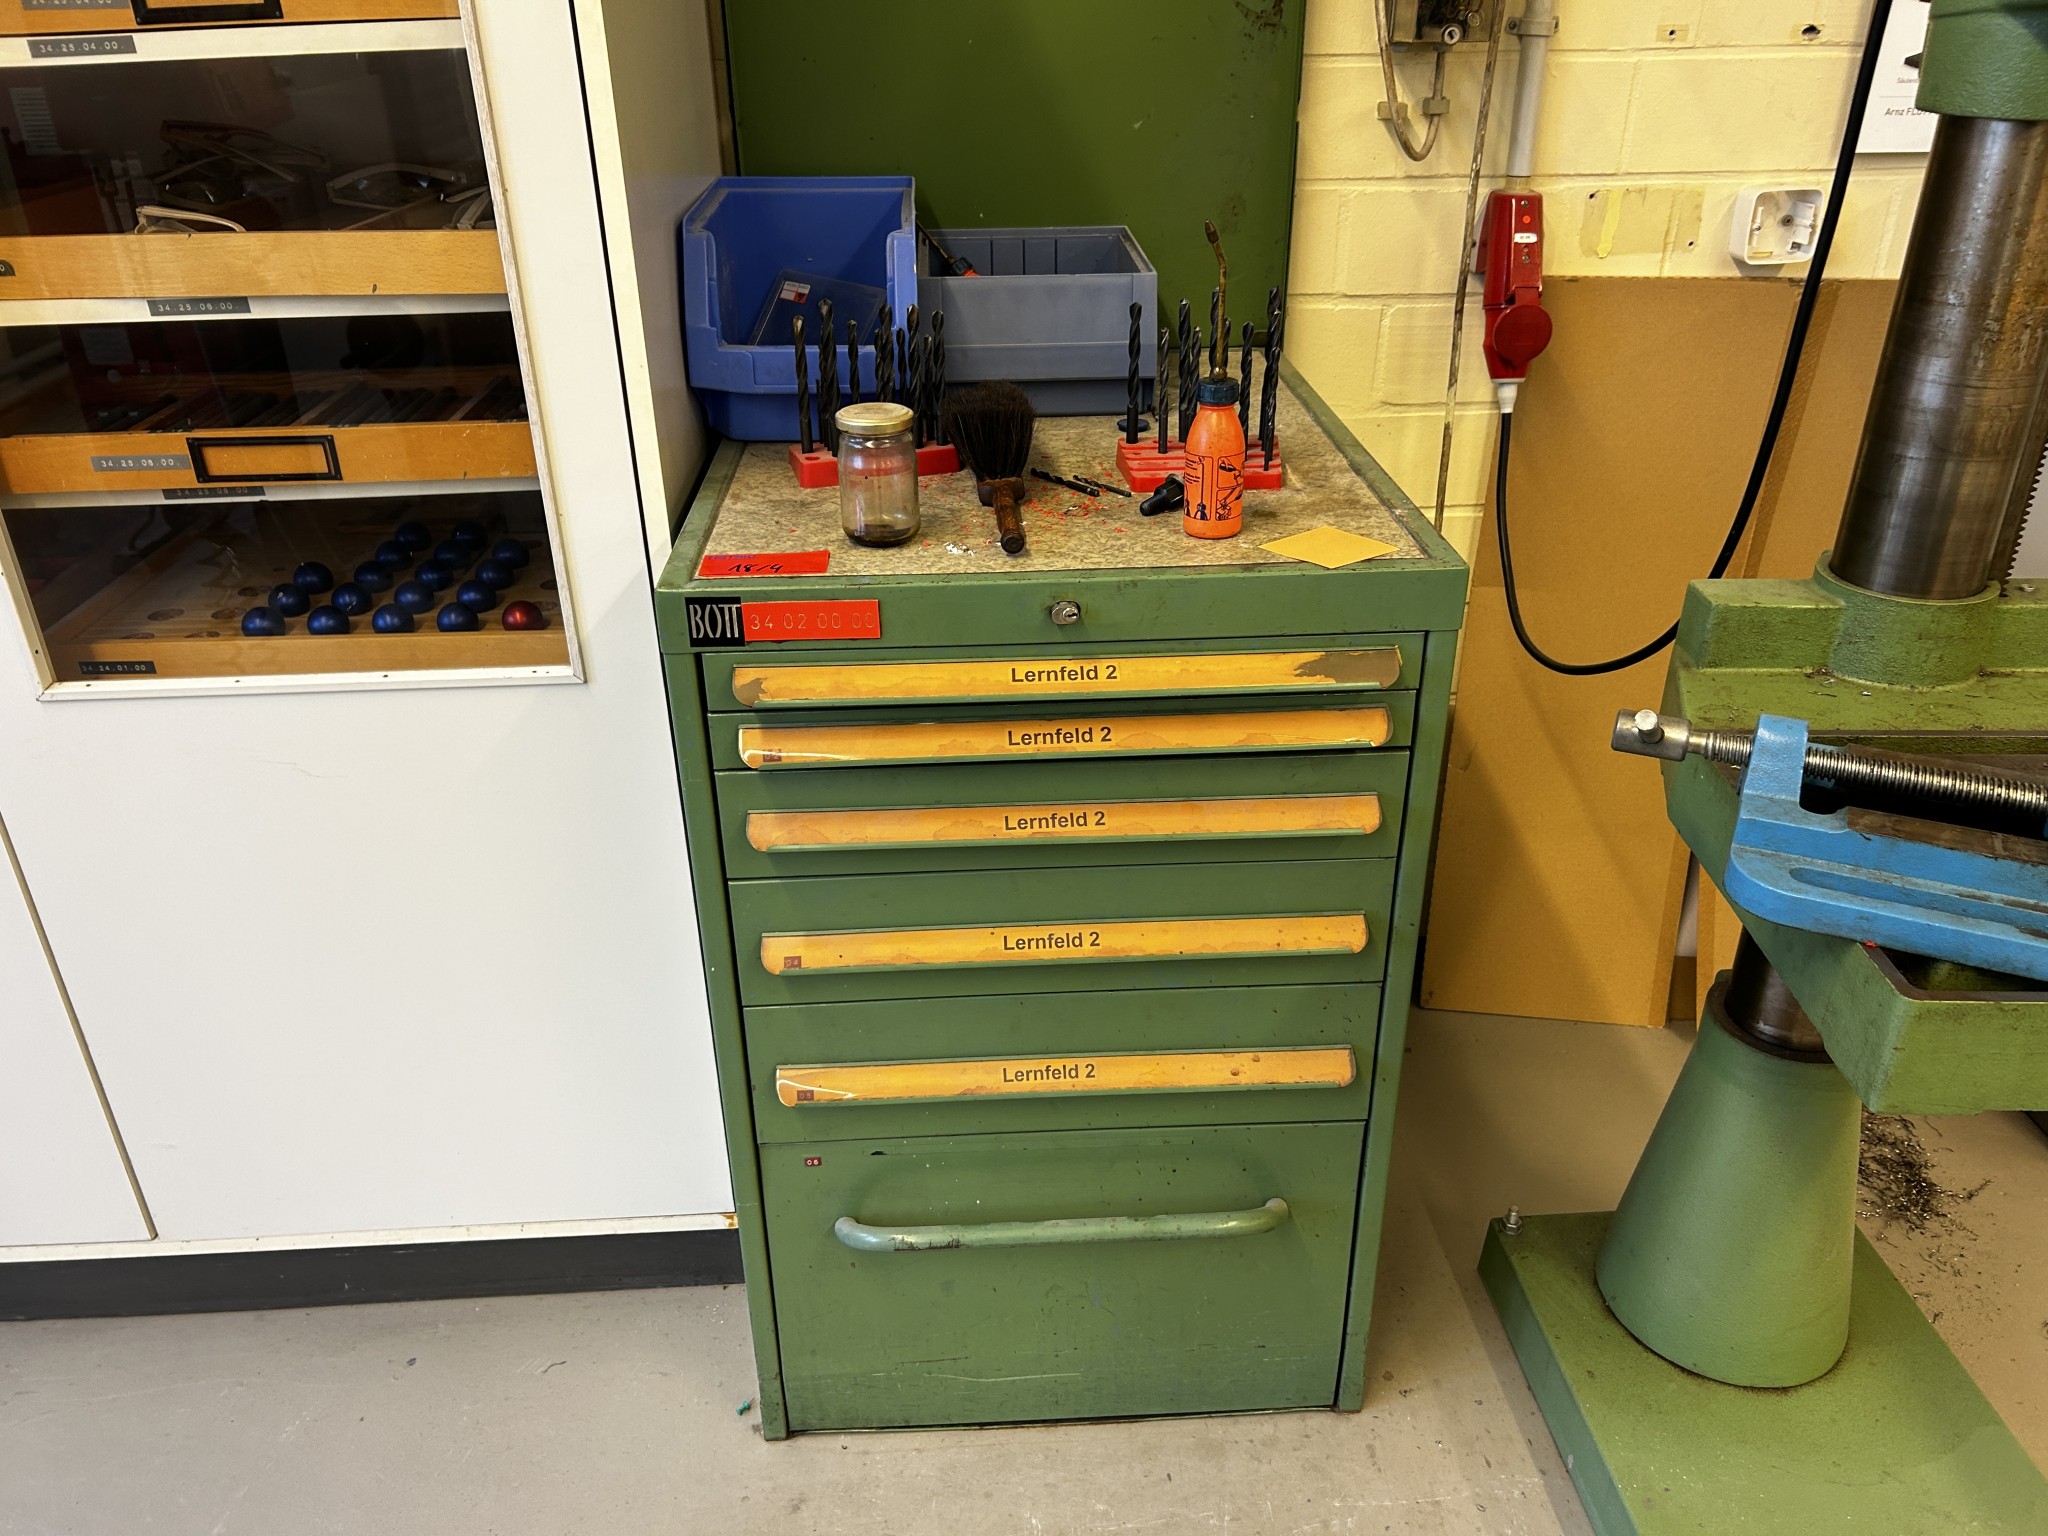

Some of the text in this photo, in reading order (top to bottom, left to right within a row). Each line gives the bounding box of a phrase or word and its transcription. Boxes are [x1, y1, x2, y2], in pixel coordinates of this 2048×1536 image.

[1012, 664, 1118, 682] Lernfeld 2
[1008, 726, 1112, 746] Lernfeld 2
[1004, 810, 1106, 831] Lernfeld 2
[1003, 931, 1100, 951] Lernfeld 2
[1002, 1063, 1096, 1083] Lernfeld 2
